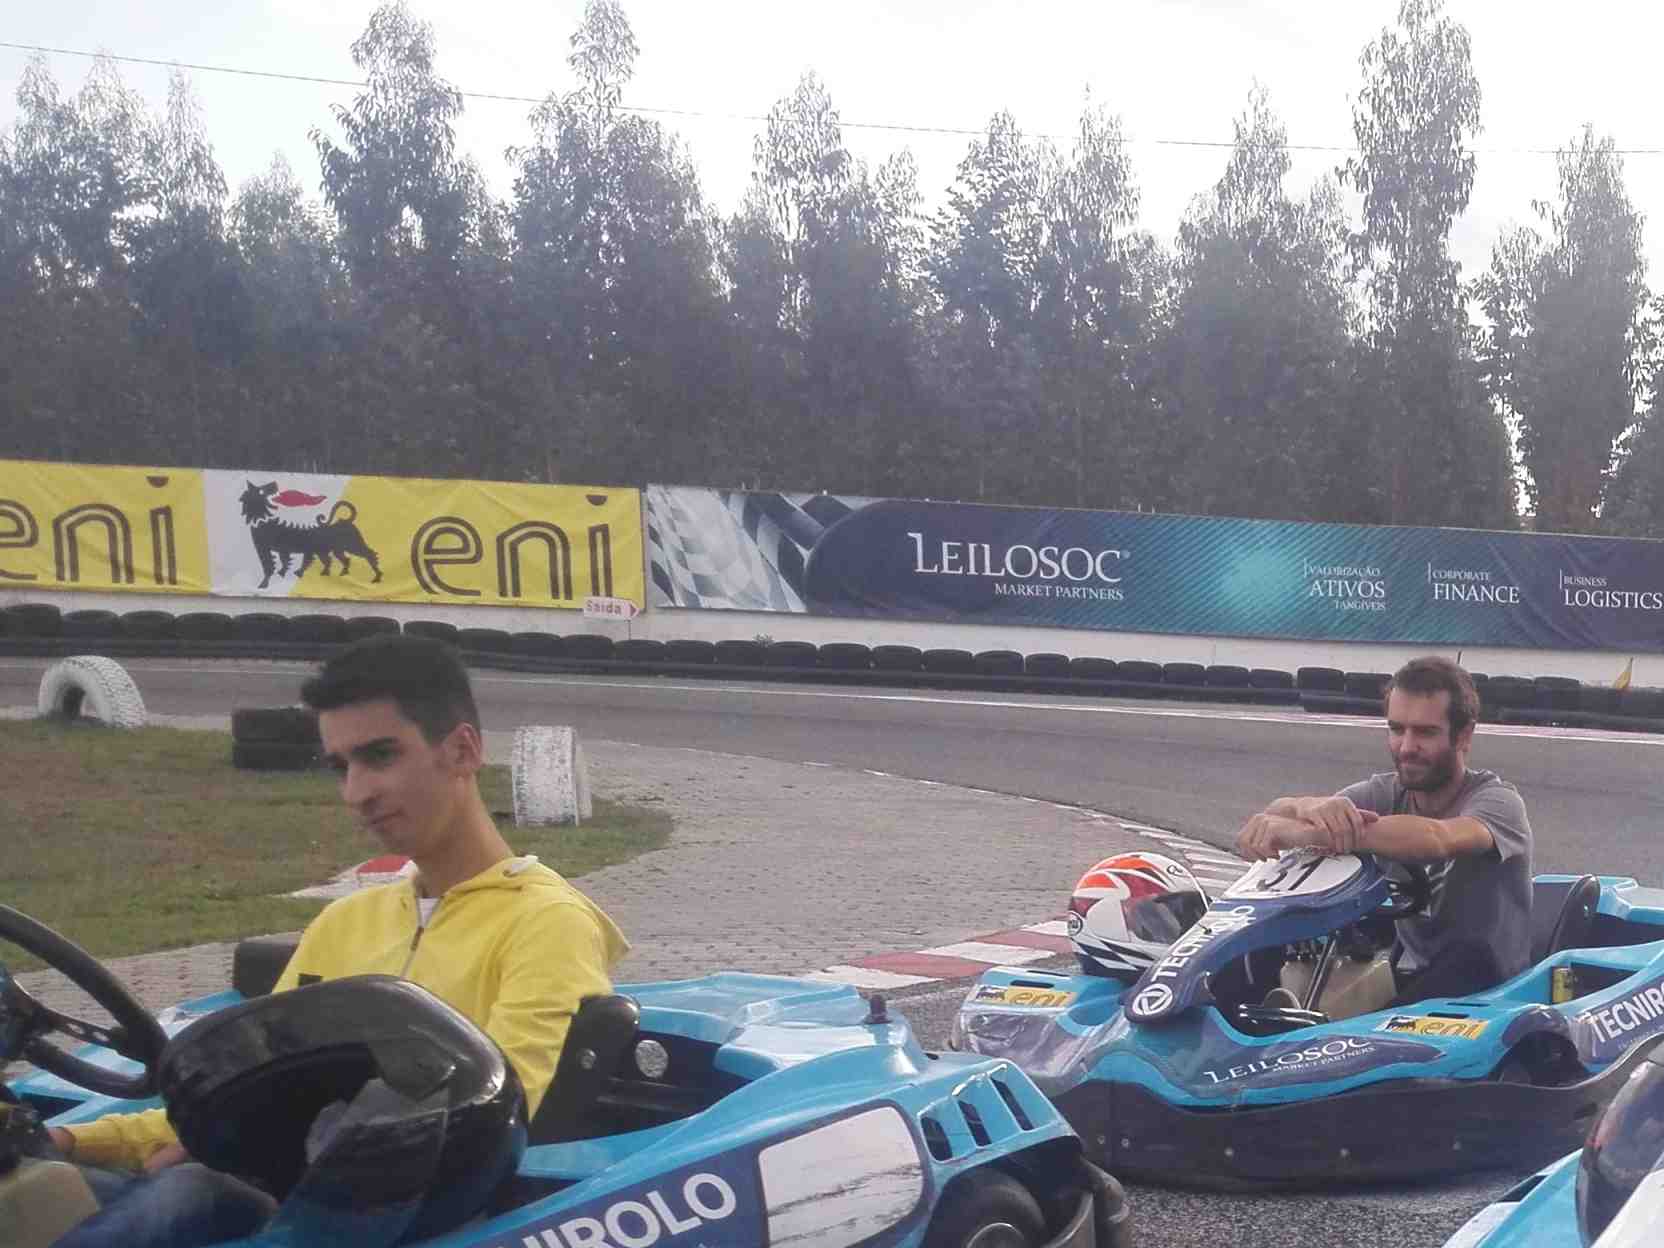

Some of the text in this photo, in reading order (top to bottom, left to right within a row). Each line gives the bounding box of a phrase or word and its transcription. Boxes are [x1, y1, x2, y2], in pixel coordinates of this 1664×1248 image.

[411, 494, 609, 600] eni
[907, 532, 1123, 583] LEILOSOC
[1433, 571, 1489, 582] CORPORATE
[1564, 576, 1608, 587] BUSINESS
[994, 582, 1124, 602] MARKET PARTNERS
[1309, 579, 1386, 599] ATIVOS
[1434, 583, 1520, 604] FINANCE
[1565, 589, 1664, 610] LOGISTICS
[1421, 1020, 1484, 1039] eni
[1203, 1038, 1372, 1084] LEILOSOC
